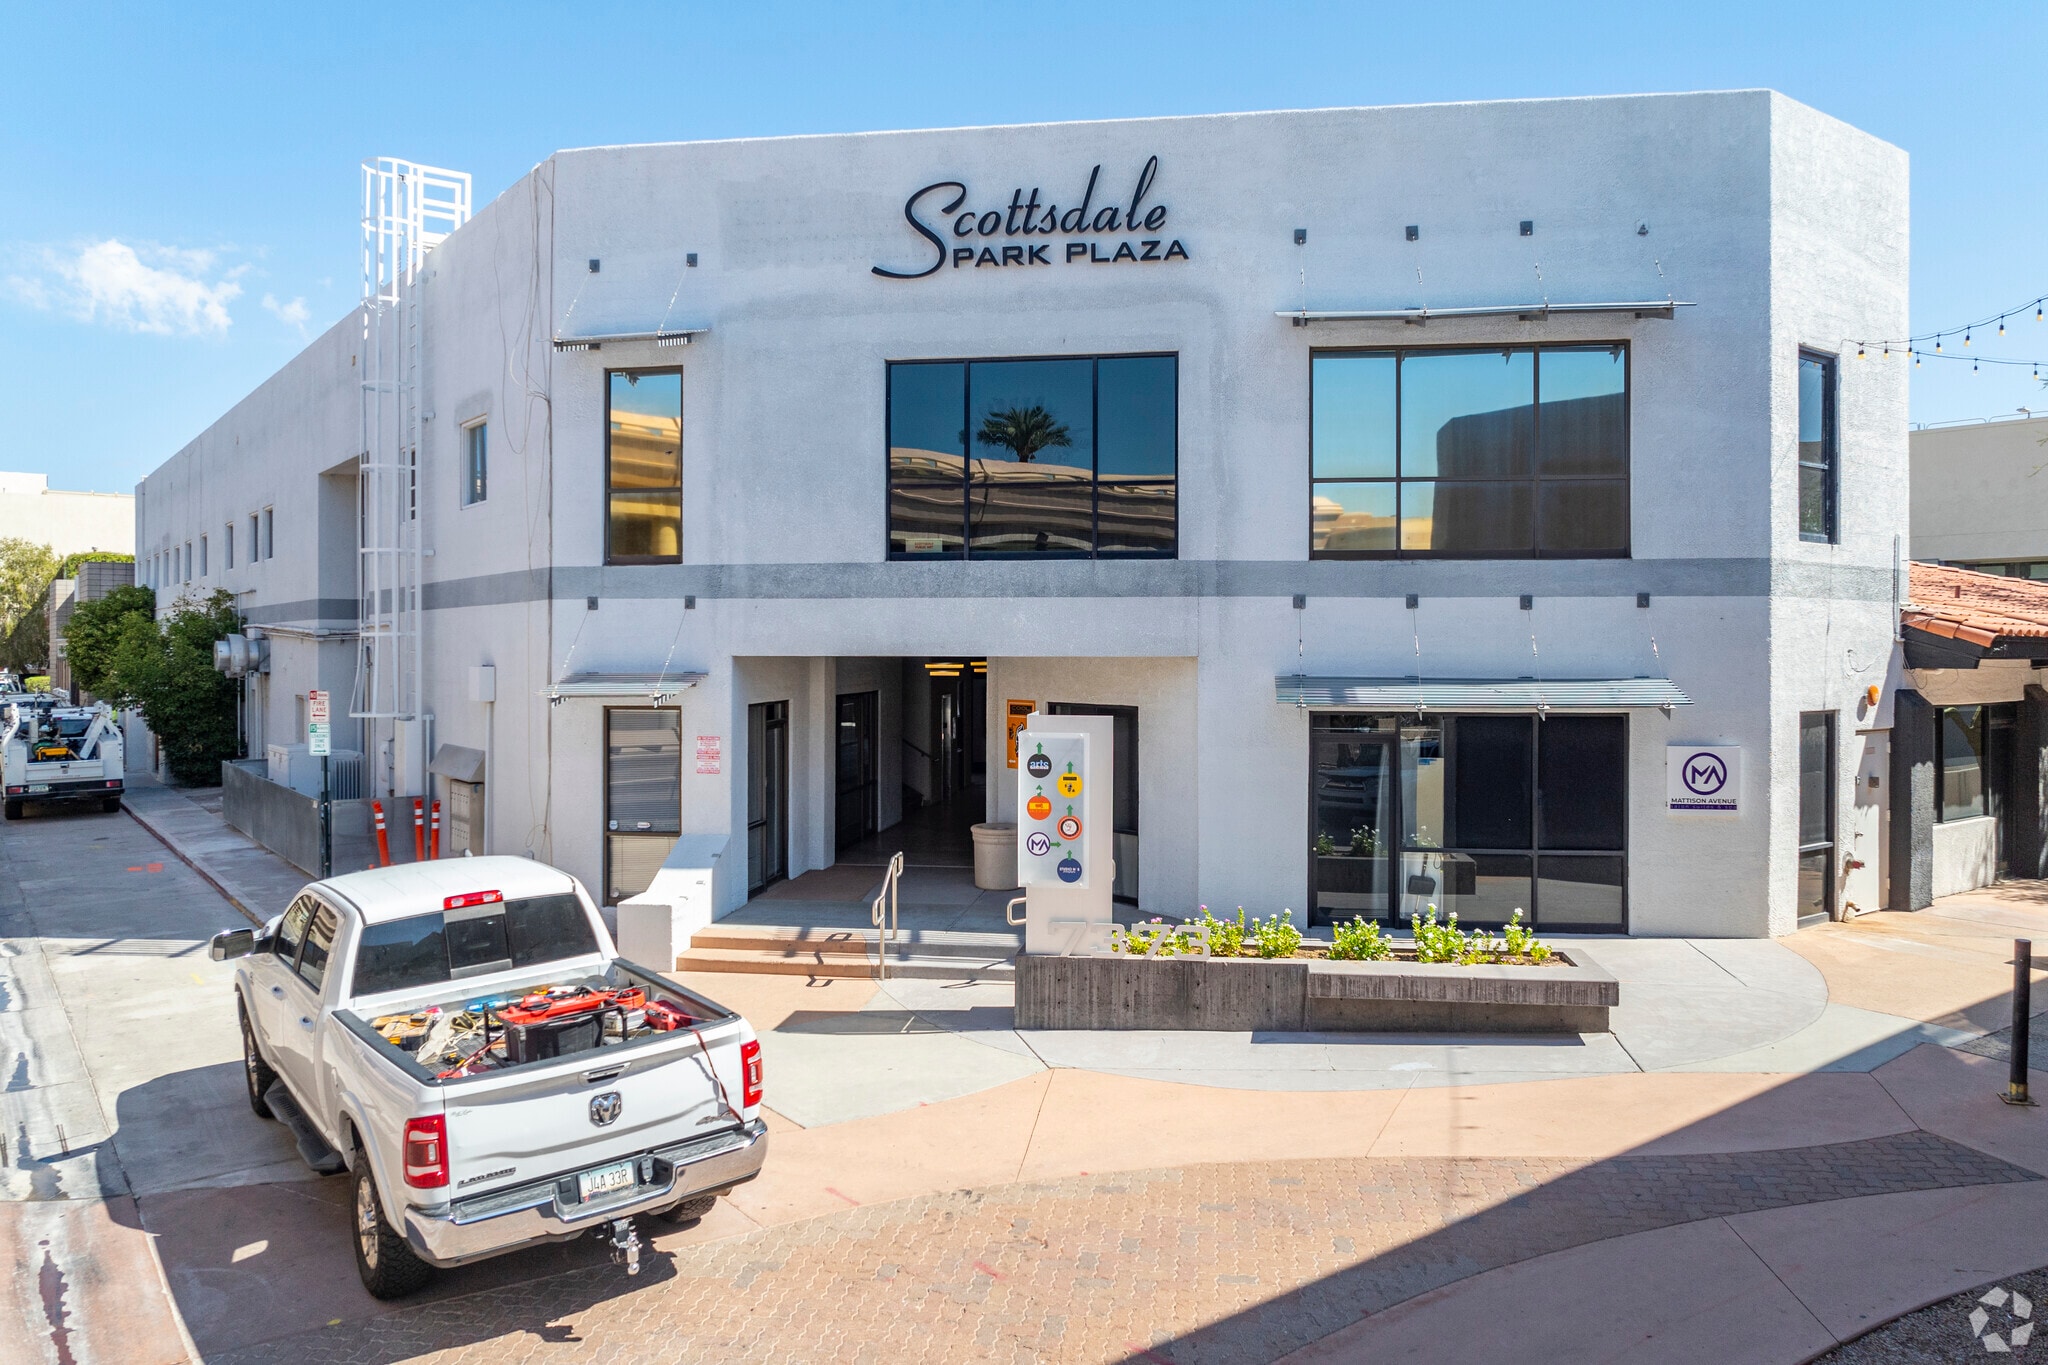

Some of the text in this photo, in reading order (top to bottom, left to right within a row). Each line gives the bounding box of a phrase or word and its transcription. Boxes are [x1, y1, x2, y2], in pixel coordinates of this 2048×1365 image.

[871, 155, 1167, 279] Scottsdale
[952, 239, 1190, 268] PARK PLAZA
[1049, 921, 1211, 961] 7373
[609, 1169, 628, 1187] 33R
